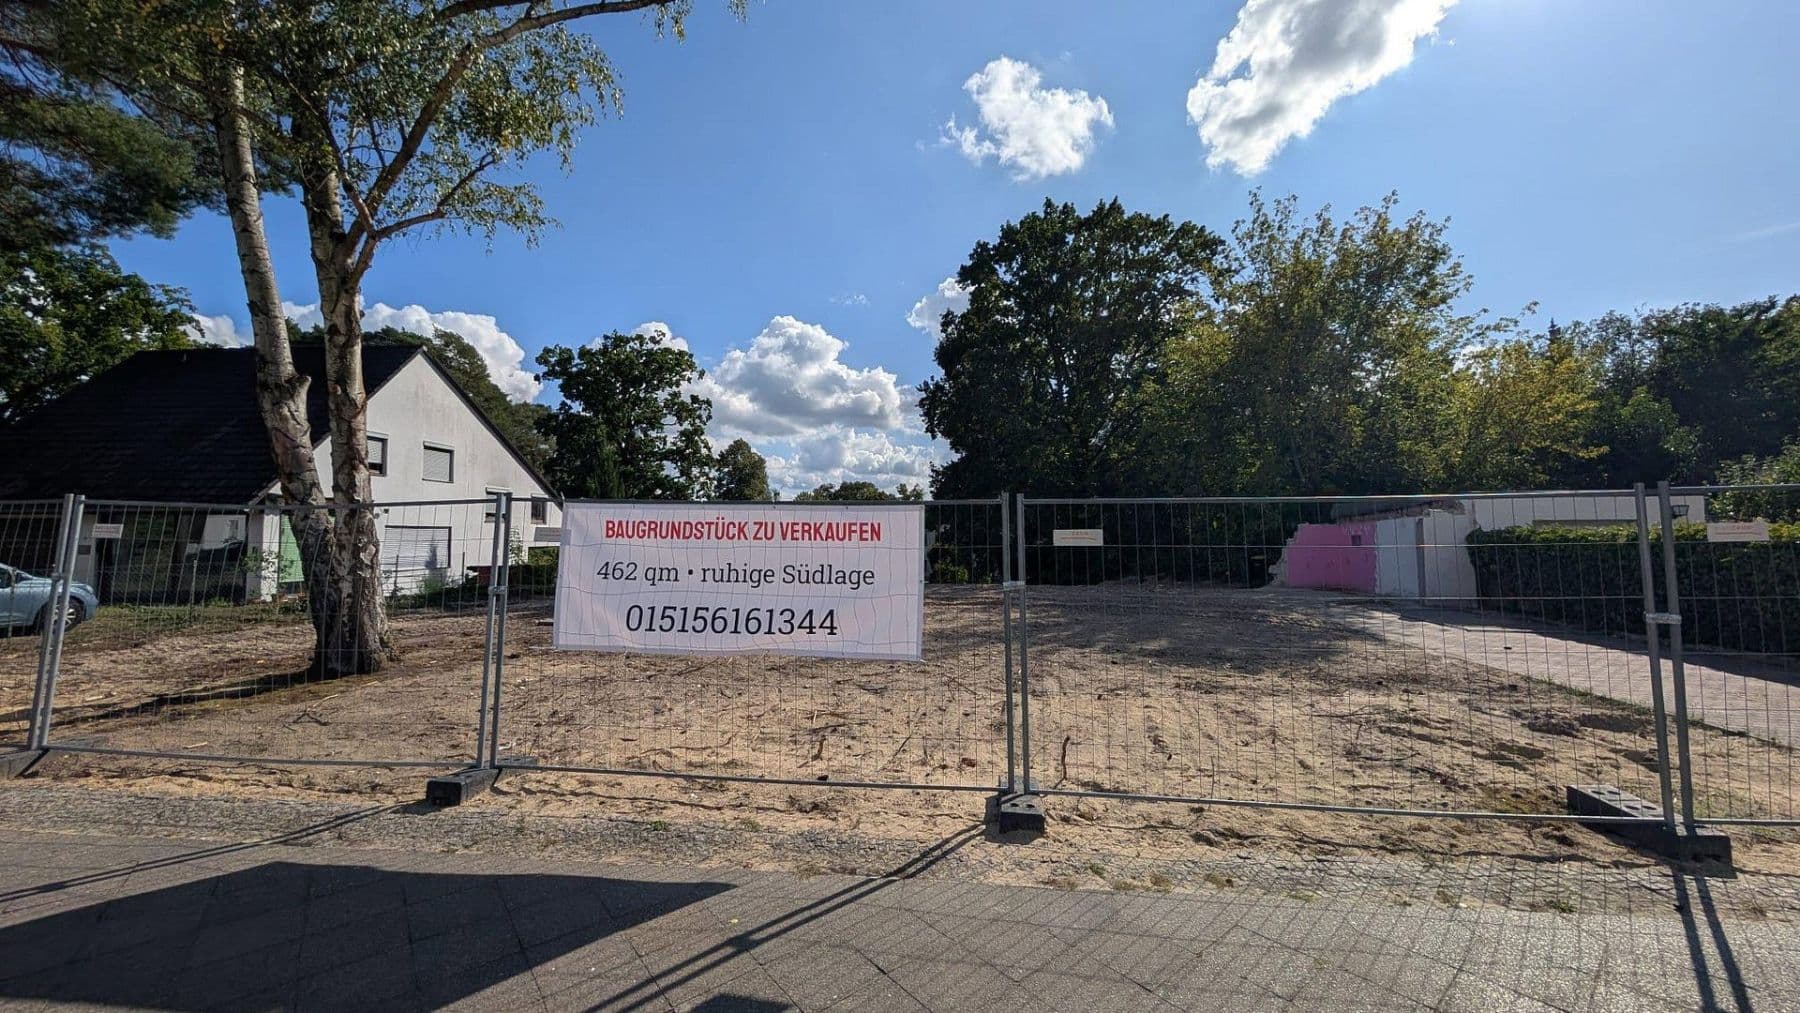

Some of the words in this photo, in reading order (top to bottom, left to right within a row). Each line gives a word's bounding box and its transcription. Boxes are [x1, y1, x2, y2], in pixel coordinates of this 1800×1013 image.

[605, 516, 748, 540] BAUGRUNDSTÜCK
[753, 521, 775, 541] ZU
[780, 521, 881, 542] VERKAUFEN
[597, 561, 637, 581] 462
[645, 566, 679, 586] qm
[700, 562, 775, 588] ruhige
[782, 564, 875, 590] Südlage
[625, 604, 838, 636] 015156161344
